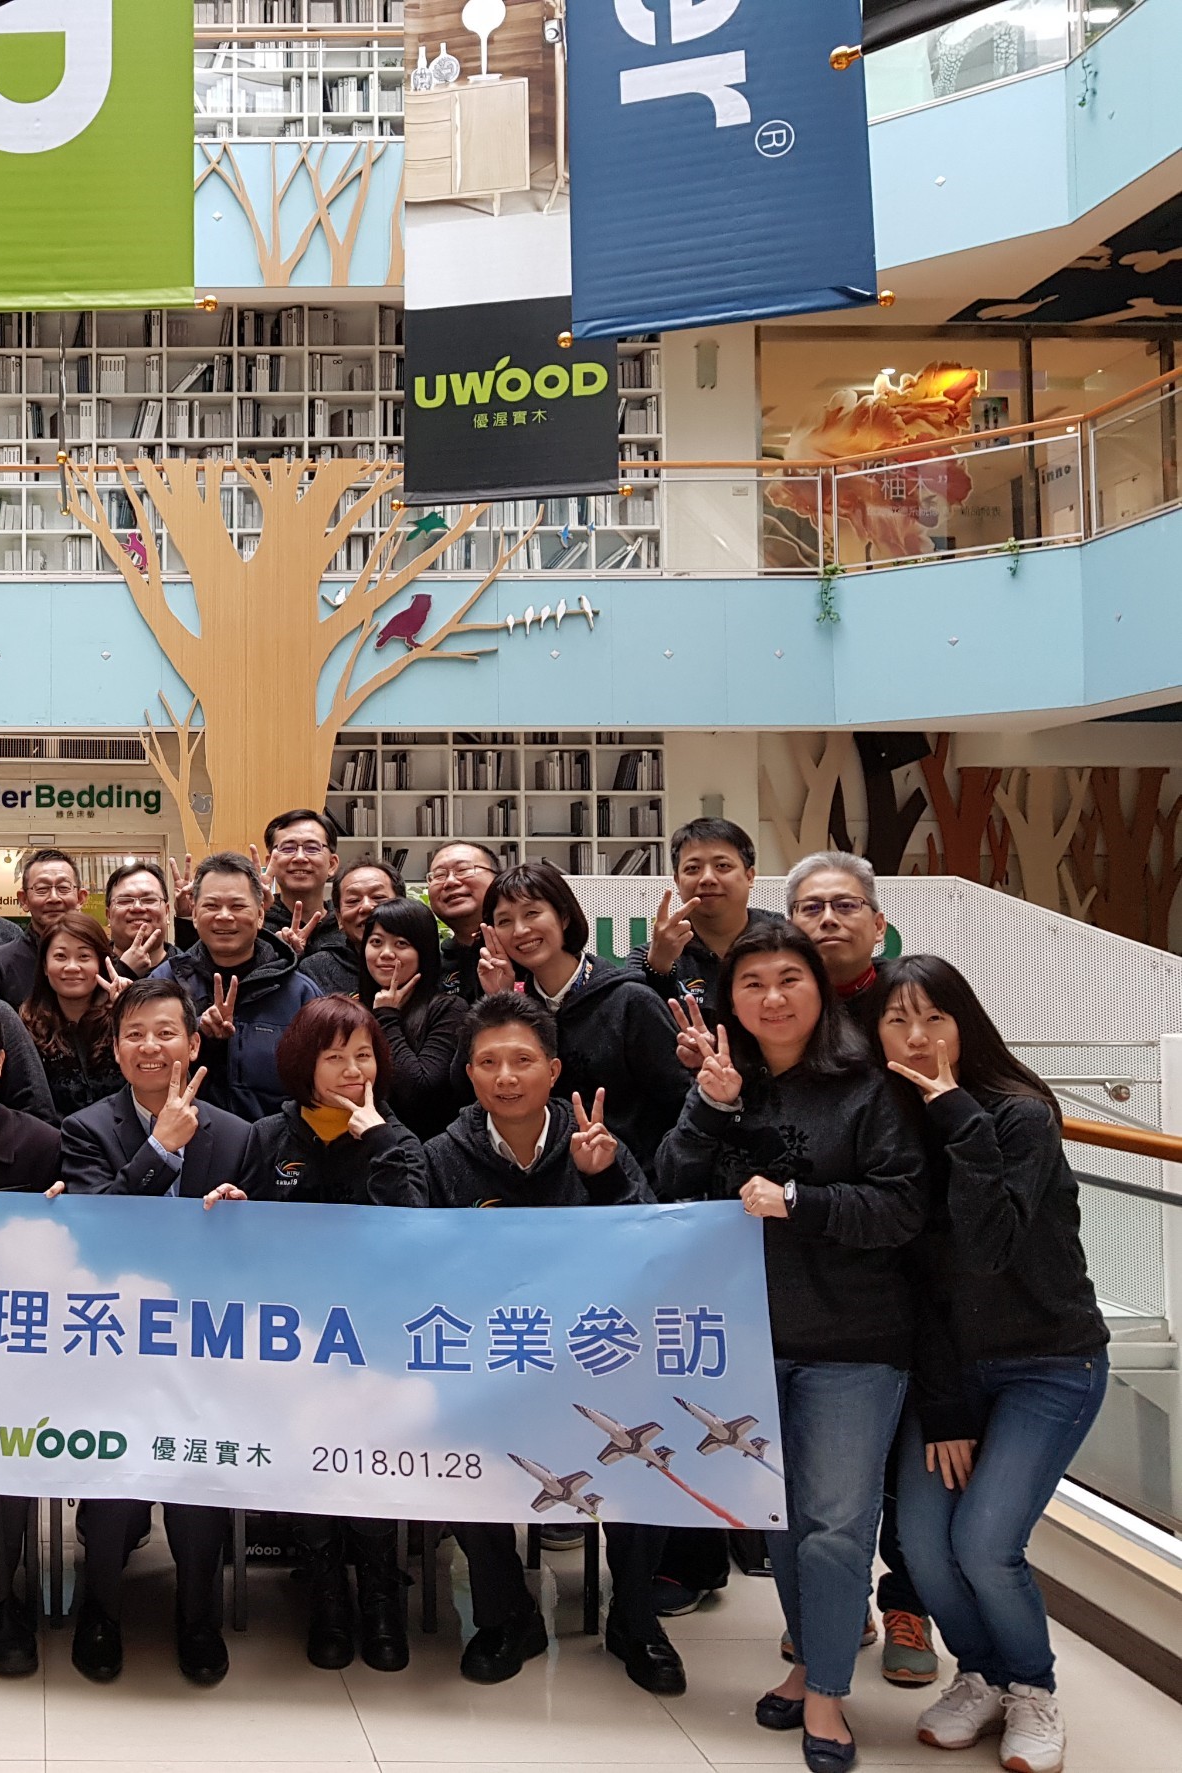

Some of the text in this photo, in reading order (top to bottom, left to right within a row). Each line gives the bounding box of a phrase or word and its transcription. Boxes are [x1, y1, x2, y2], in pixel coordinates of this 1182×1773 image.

[414, 357, 609, 409] UWOOD
[473, 409, 548, 429] 優渥實木
[1041, 464, 1072, 485] inno
[403, 1303, 728, 1379] 企業參訪
[151, 1435, 273, 1467] 優渥實木
[311, 1446, 484, 1480] 2018.01.28
[245, 1544, 282, 1556] WOOD
